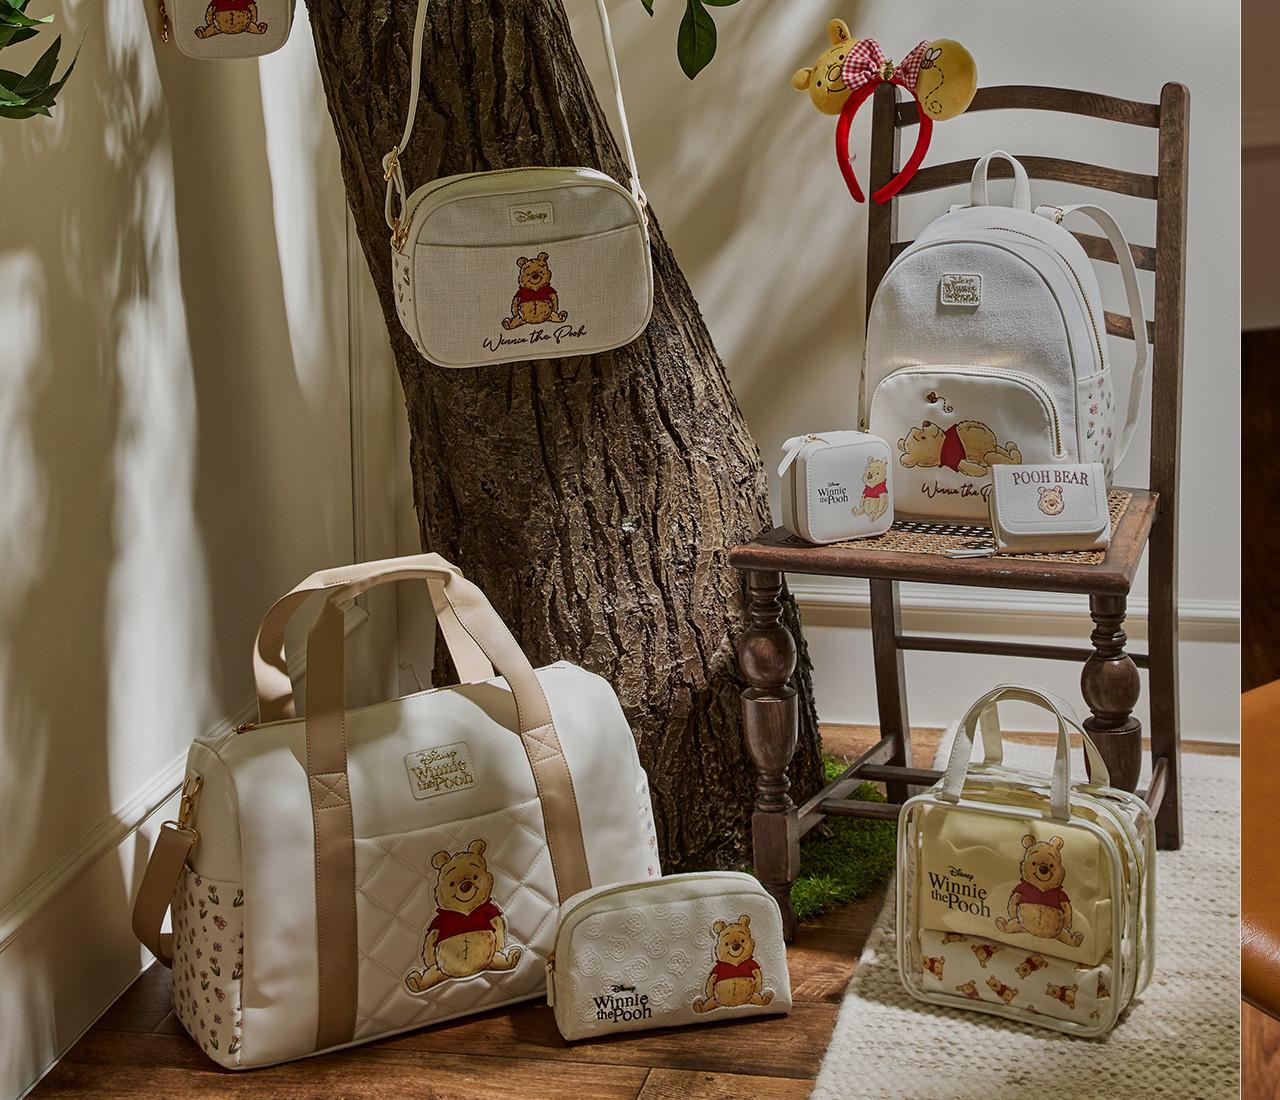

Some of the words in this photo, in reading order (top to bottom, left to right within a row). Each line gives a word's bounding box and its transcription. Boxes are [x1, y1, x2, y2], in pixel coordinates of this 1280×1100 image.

[482, 333, 529, 353] Winnie
[529, 328, 552, 345] the
[553, 324, 587, 345] Pooh
[1012, 470, 1051, 486] POOH
[1053, 470, 1089, 486] BEAR
[817, 486, 848, 497] Winnie
[828, 493, 849, 505] Pooh
[921, 480, 960, 499] Winnie
[960, 483, 980, 498] the
[409, 760, 466, 783] Winnie
[416, 780, 436, 791] the
[432, 772, 474, 792] Pooh
[947, 865, 975, 882] Disney
[928, 871, 988, 901] Winnie
[930, 889, 949, 904] the
[947, 892, 991, 918] Pooh
[610, 984, 637, 994] Disney
[592, 993, 649, 1010] Winnie
[596, 1009, 615, 1020] the
[612, 1002, 653, 1023] Pooh
